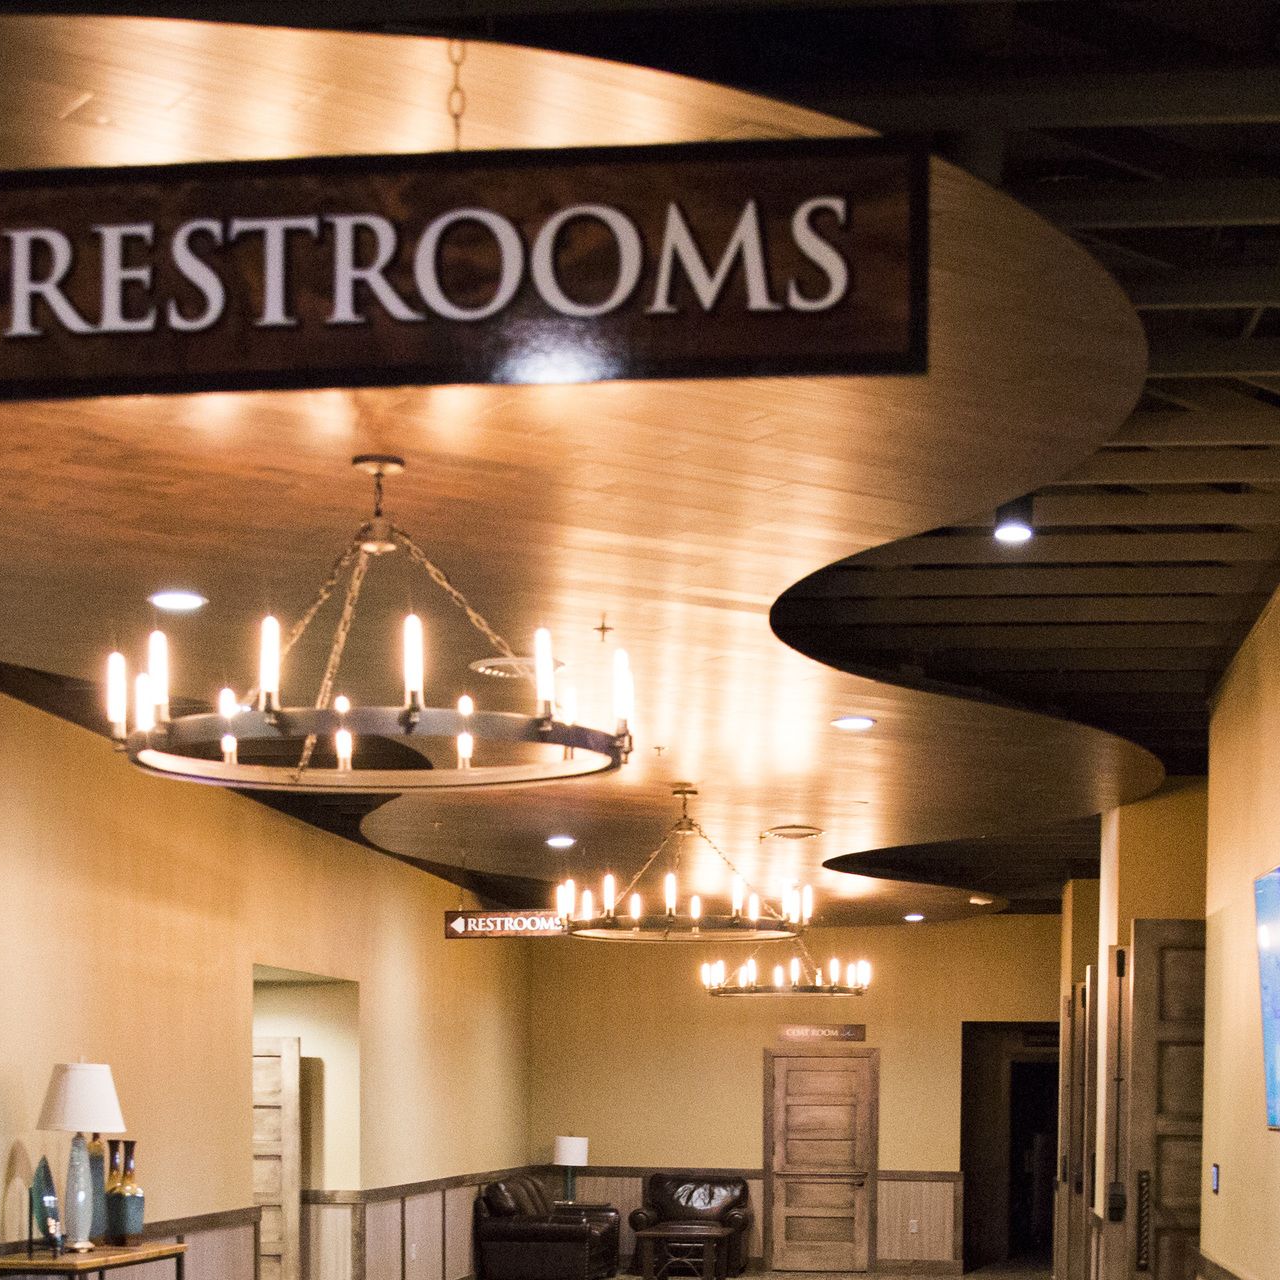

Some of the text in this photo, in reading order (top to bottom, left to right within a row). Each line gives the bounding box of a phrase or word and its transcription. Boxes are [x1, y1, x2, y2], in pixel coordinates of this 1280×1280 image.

[3, 197, 849, 340] RESTROOMS
[467, 915, 563, 932] RESTROOMS
[811, 1028, 839, 1037] ROOM
